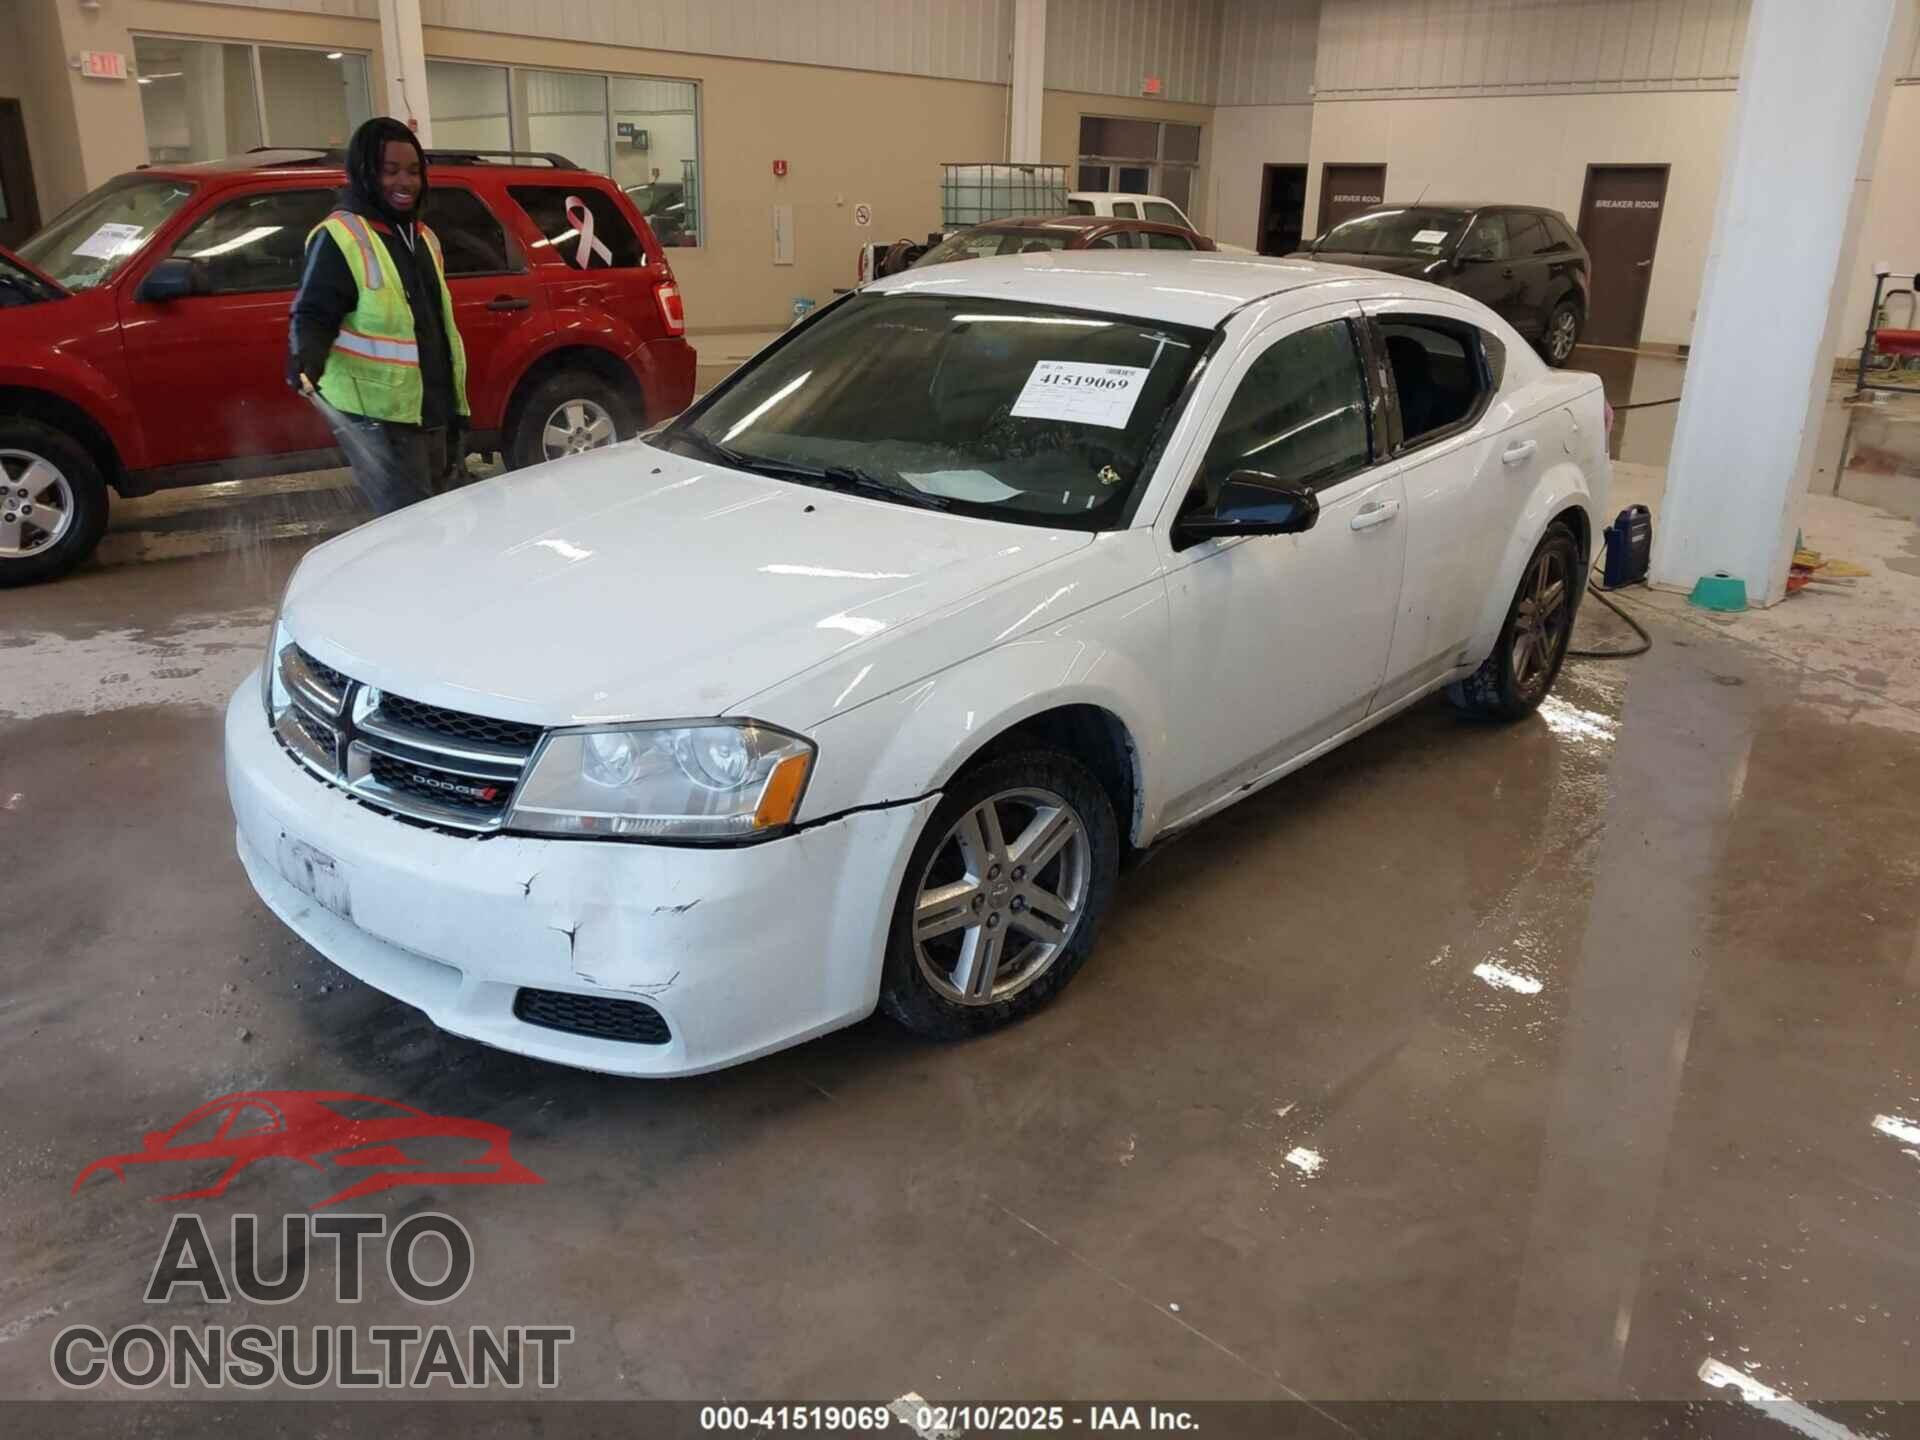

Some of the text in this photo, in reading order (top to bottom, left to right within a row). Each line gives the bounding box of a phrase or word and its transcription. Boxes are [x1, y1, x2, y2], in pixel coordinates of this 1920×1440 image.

[1595, 199, 1660, 209] BREAKER ROOM
[1040, 373, 1129, 390] 41519069
[412, 774, 485, 798] DODGE
